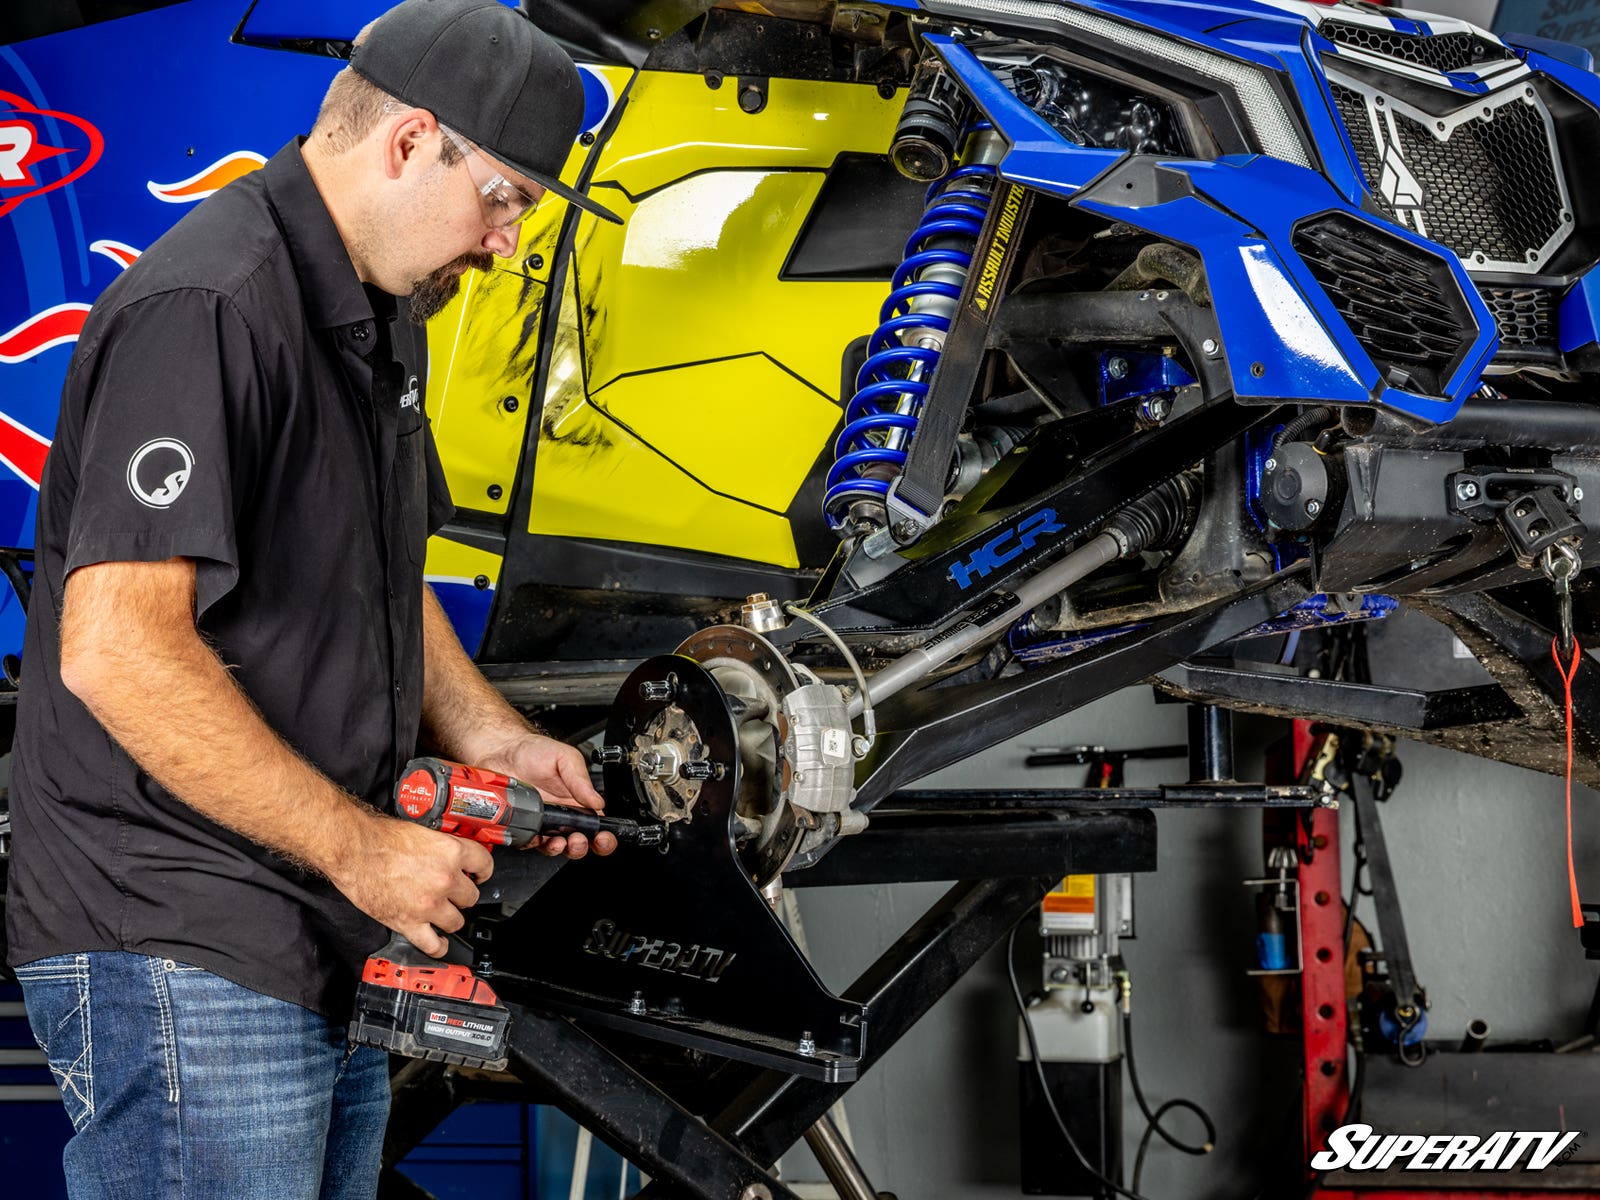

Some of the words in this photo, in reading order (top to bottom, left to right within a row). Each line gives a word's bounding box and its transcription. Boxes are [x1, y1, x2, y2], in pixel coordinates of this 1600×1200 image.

[977, 238, 1006, 299] ASSAULT
[948, 508, 1067, 590] HCR
[401, 784, 432, 797] FUEL
[431, 1013, 447, 1022] M18
[427, 1025, 444, 1033] HIGH
[445, 1028, 471, 1037] OUTPUT
